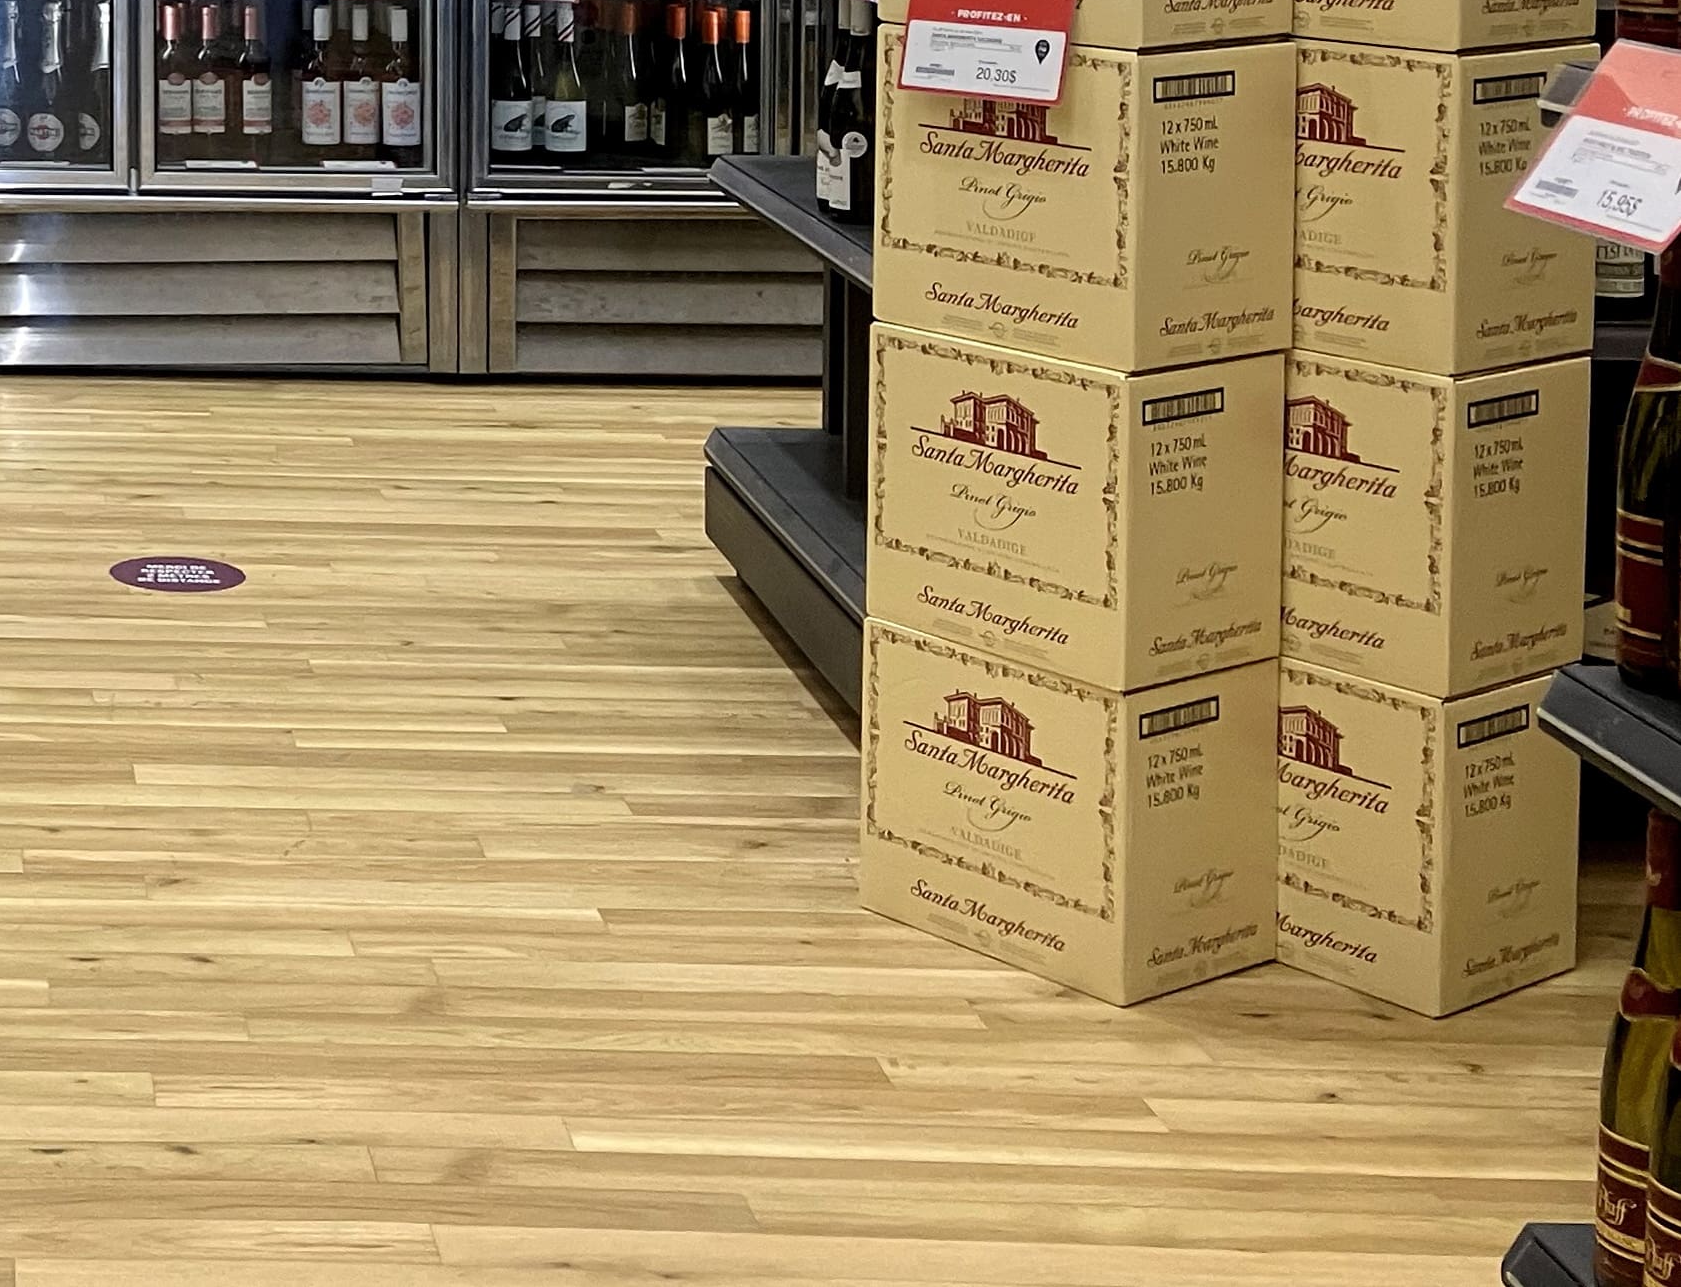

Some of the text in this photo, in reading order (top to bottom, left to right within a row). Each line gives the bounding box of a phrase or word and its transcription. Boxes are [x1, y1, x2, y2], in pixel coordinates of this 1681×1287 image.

[957, 9, 1021, 23] PROFITEZ-EN
[976, 66, 1017, 83] 20,30$
[920, 130, 1092, 179] Santa Margherita
[1160, 136, 1219, 154] White Wine
[1161, 156, 1216, 174] 15.800 Kg
[958, 176, 1047, 209] Pinot Grigio
[1306, 187, 1354, 215] Grigio
[924, 281, 1079, 329] Santa Margherita
[1159, 306, 1276, 337] Santa Margherita
[912, 435, 1079, 496] Santa Margherita
[1149, 455, 1207, 477] White Wine
[1150, 476, 1204, 497] 15.800 Kg
[950, 483, 1037, 522] Pinot Grigio
[1300, 498, 1347, 526] Grigio
[957, 527, 1028, 556] VALDADIGE
[917, 584, 1069, 645] Santa Margherita
[904, 729, 1075, 805] Santa Margherita
[1146, 766, 1204, 790] White Wine
[943, 780, 1032, 824] Pinot Grigio
[1147, 785, 1200, 809] 15.800 Kg
[1294, 805, 1340, 837] Grigio
[910, 878, 1066, 952] Santa Margherita
